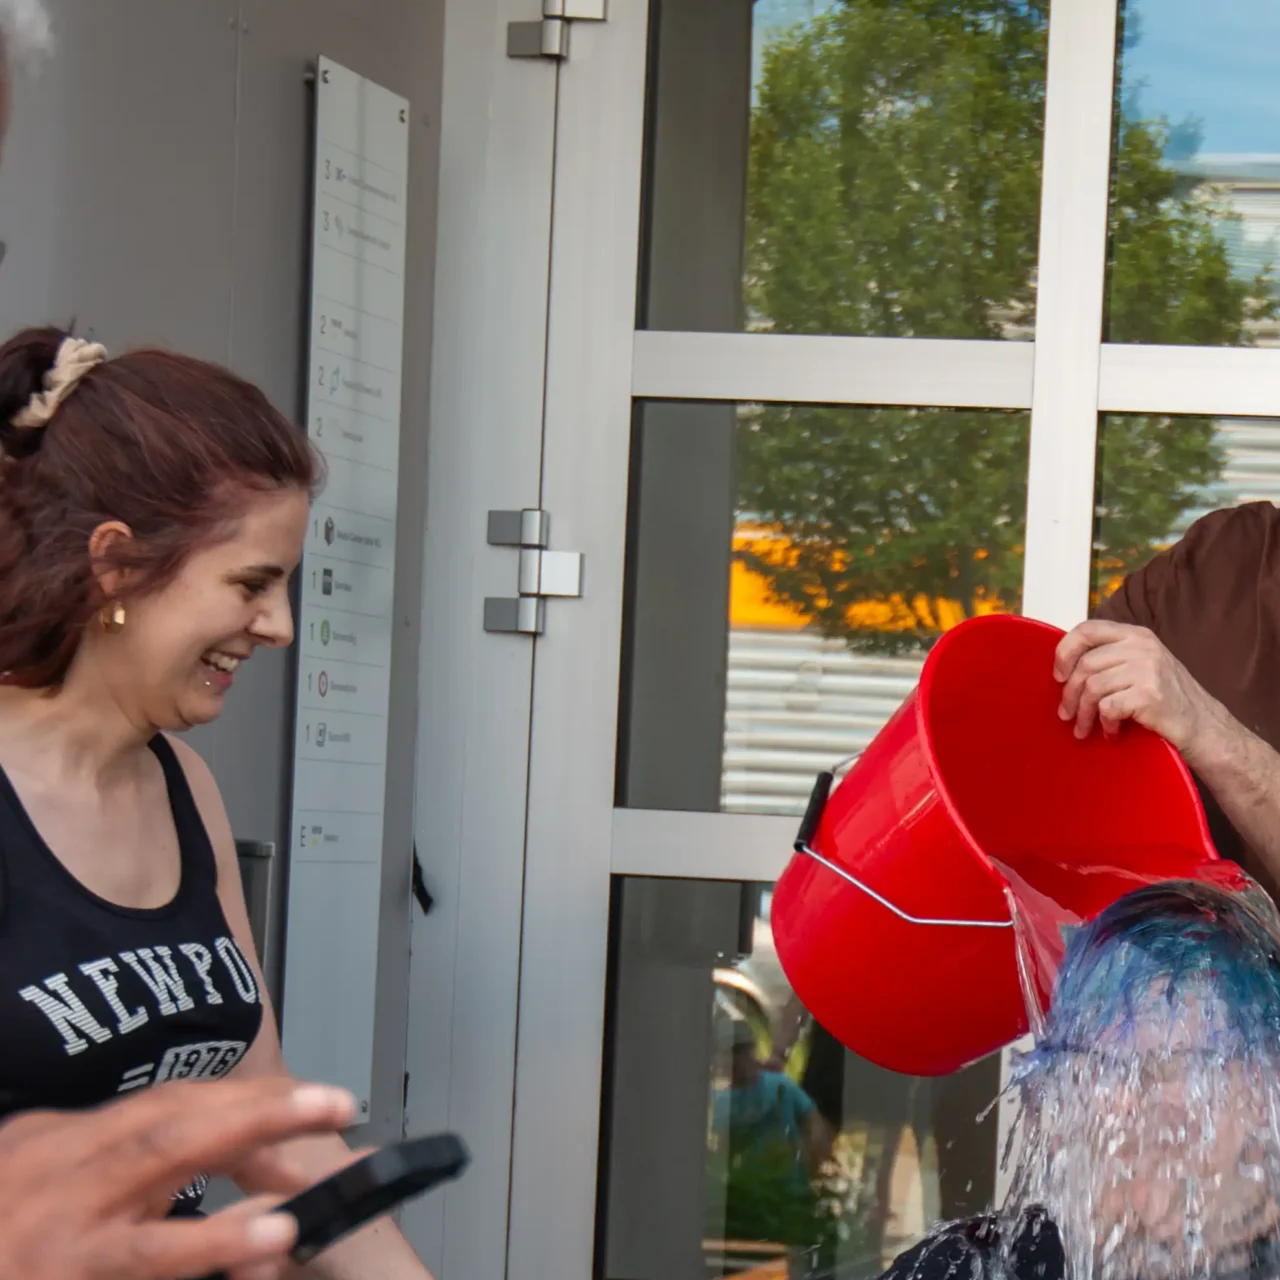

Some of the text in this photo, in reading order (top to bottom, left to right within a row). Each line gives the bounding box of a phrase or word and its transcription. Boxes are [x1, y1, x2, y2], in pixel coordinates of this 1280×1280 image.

[324, 158, 331, 180] 3
[322, 210, 330, 231] 3
[320, 315, 327, 334] 2
[318, 366, 325, 386] 2
[316, 417, 323, 437] 2
[300, 826, 307, 847] E
[163, 1047, 239, 1082] 1976
